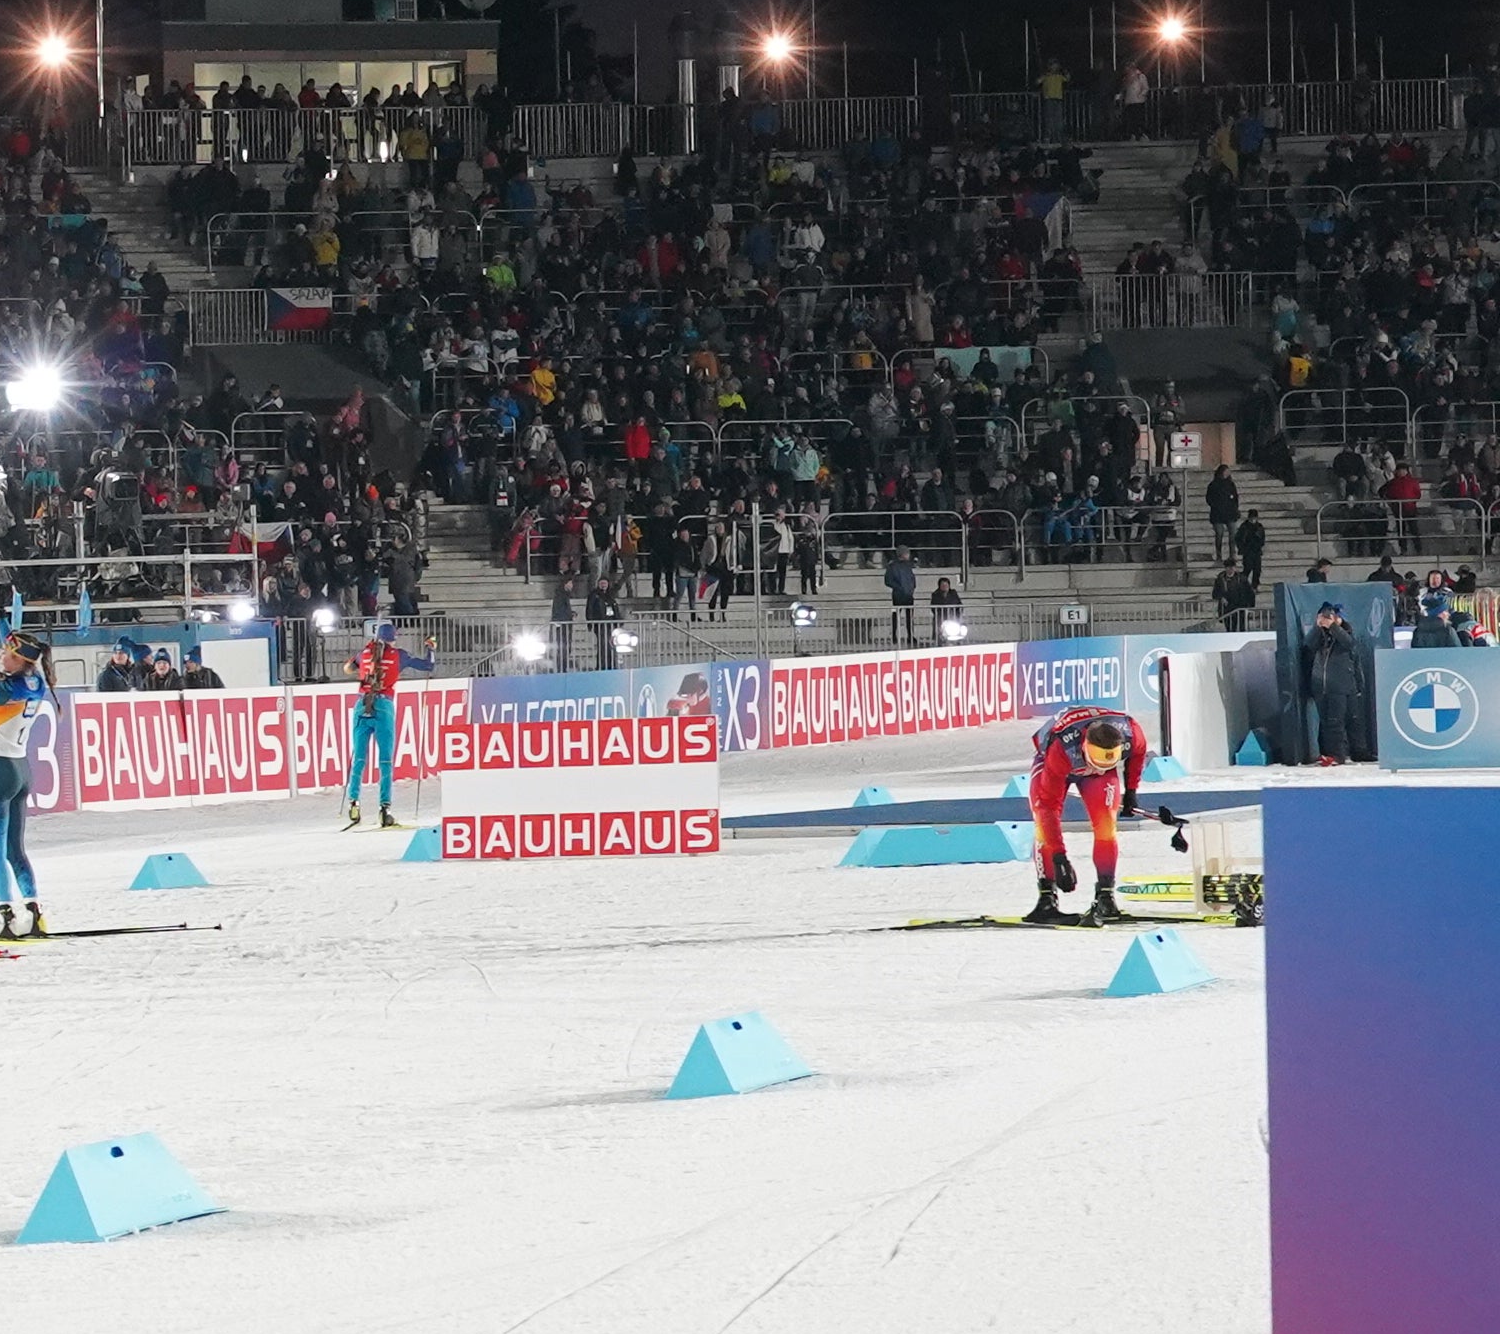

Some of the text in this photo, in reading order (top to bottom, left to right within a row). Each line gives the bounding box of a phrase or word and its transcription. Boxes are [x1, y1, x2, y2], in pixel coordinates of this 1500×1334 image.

[1067, 610, 1081, 620] E1
[724, 665, 760, 752] X3
[774, 672, 897, 736] BAUHAUS
[901, 662, 1012, 723] BAUHAUS
[1022, 656, 1121, 706] X ELECTRIFIED
[1402, 672, 1466, 695] BMW
[26, 699, 60, 809] 3
[80, 710, 284, 787] BAUHAUS
[444, 723, 712, 764] BAUHAUS
[446, 815, 714, 855] BAUHAUS
